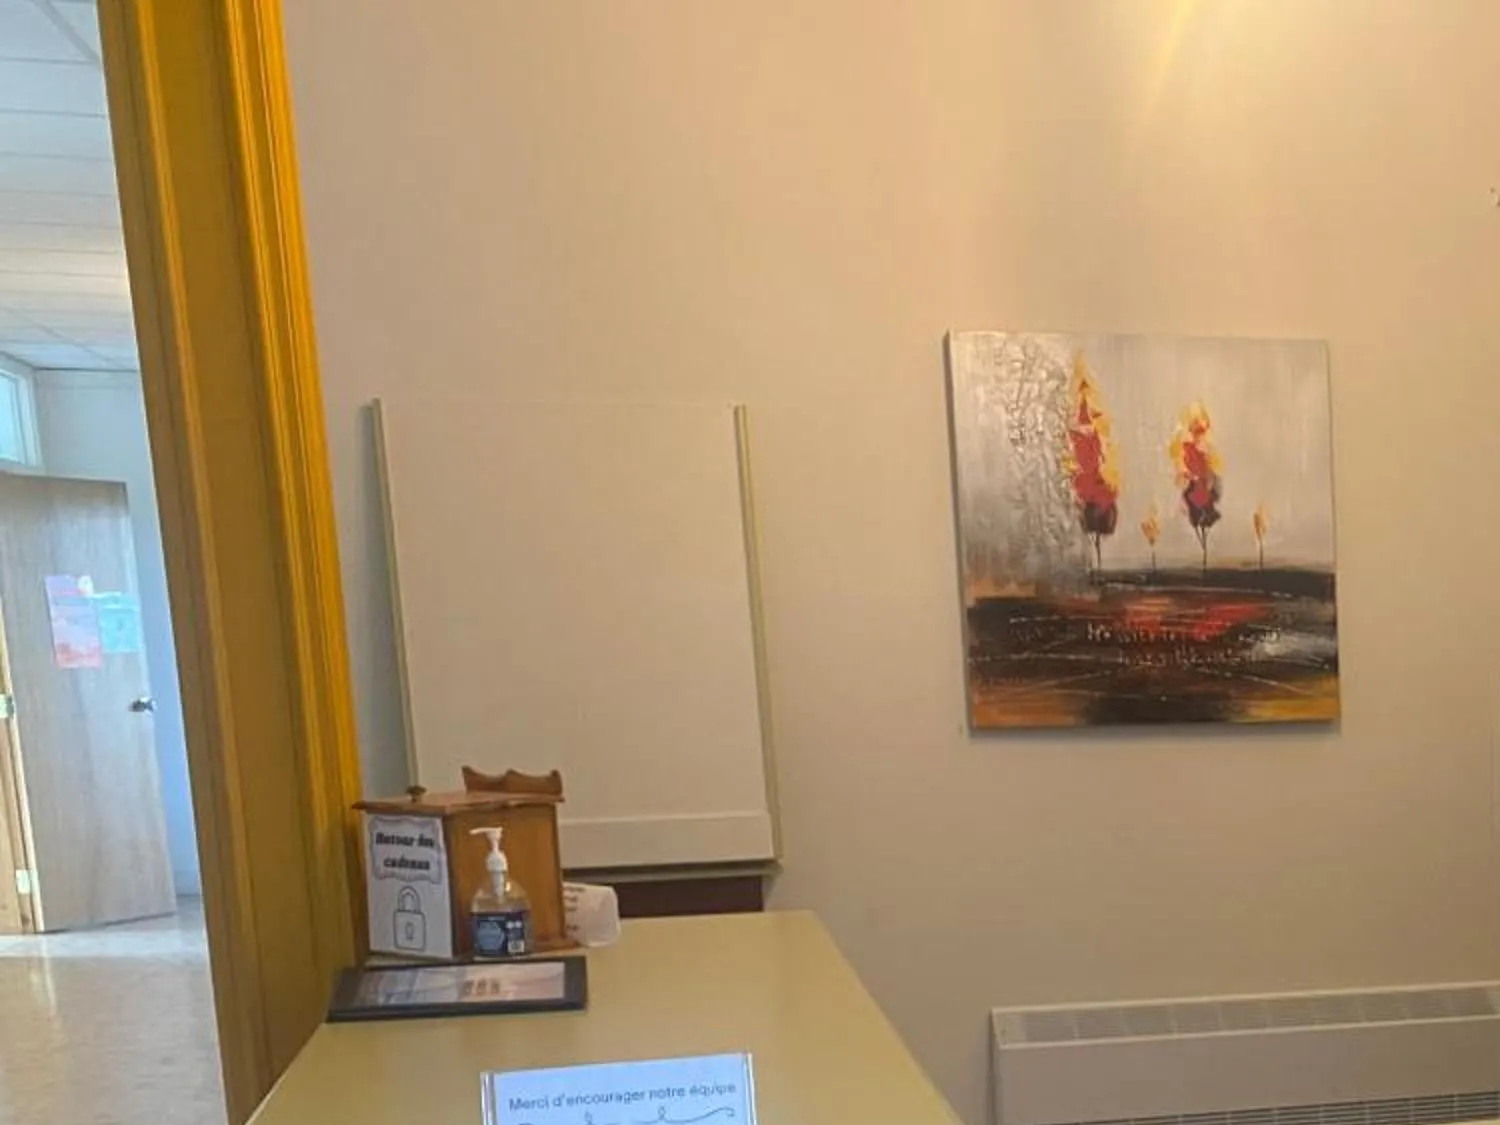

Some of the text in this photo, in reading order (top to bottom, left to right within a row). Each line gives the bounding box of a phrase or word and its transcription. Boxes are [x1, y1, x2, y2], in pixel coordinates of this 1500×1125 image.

[508, 1080, 737, 1111] Merci d'encourager notre équipe
